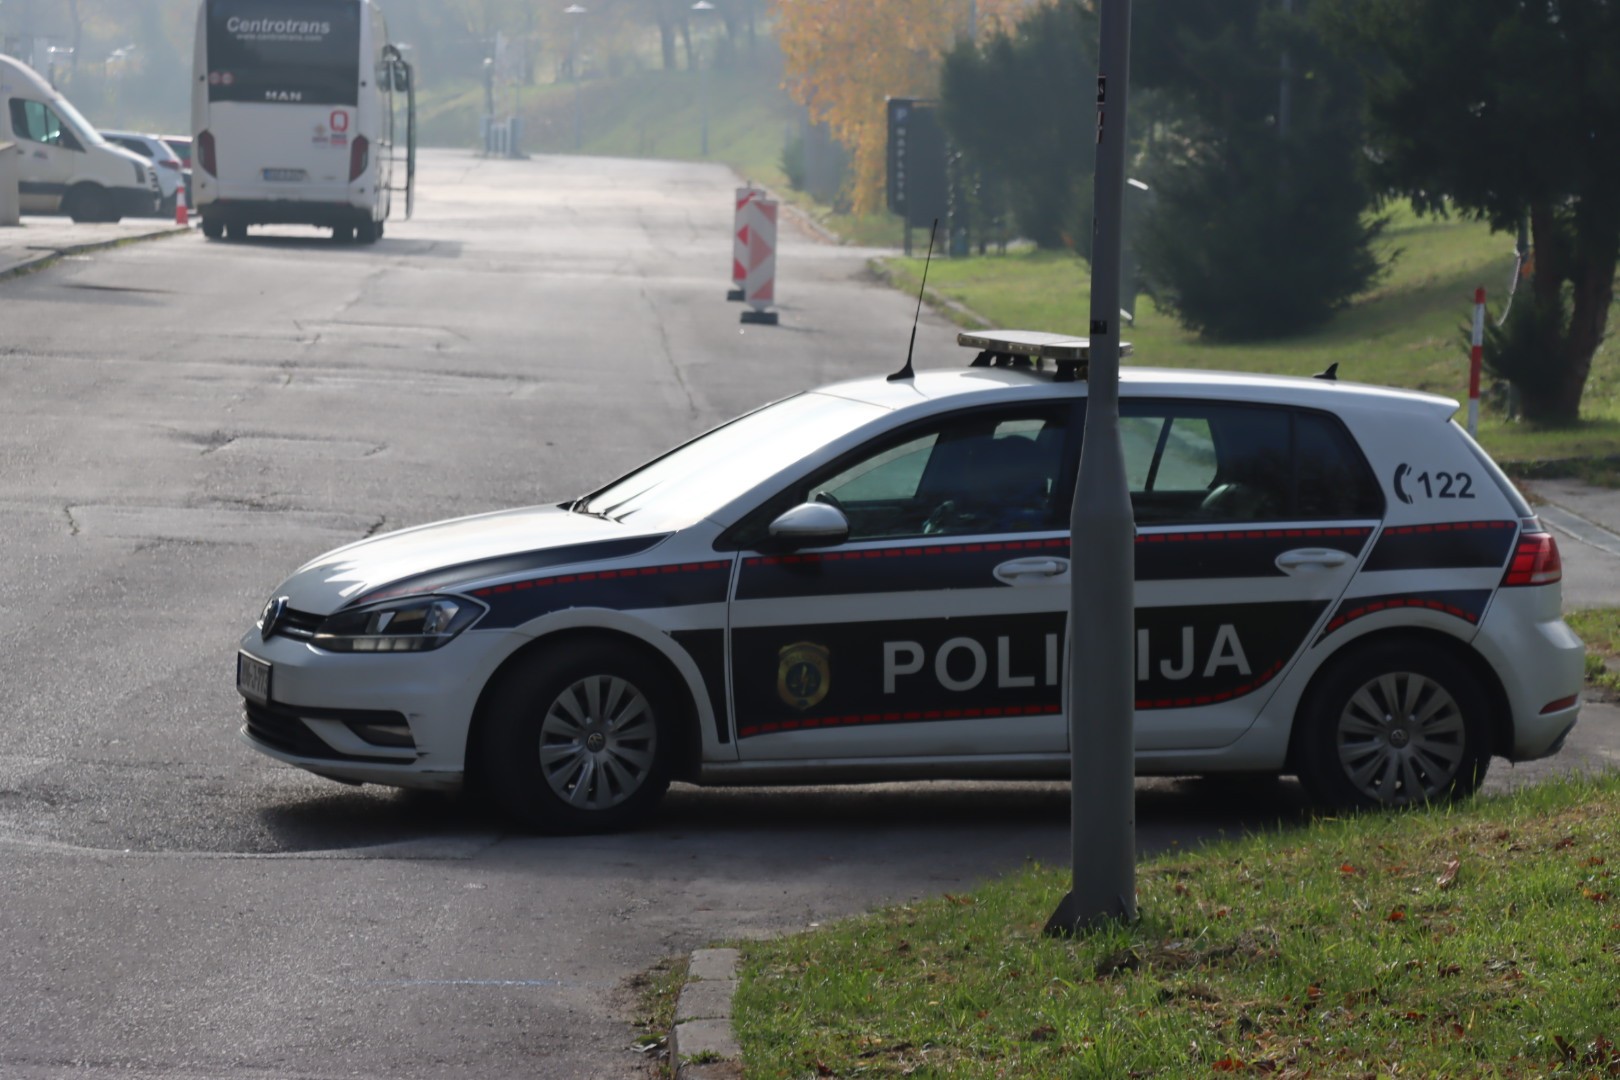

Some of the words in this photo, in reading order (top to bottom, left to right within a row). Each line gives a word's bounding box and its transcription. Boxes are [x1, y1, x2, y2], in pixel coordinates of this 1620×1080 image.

[227, 16, 331, 34] Centrotrans
[265, 91, 302, 101] MAN
[1417, 471, 1475, 499] 122
[883, 624, 1252, 694] POLIIJA
